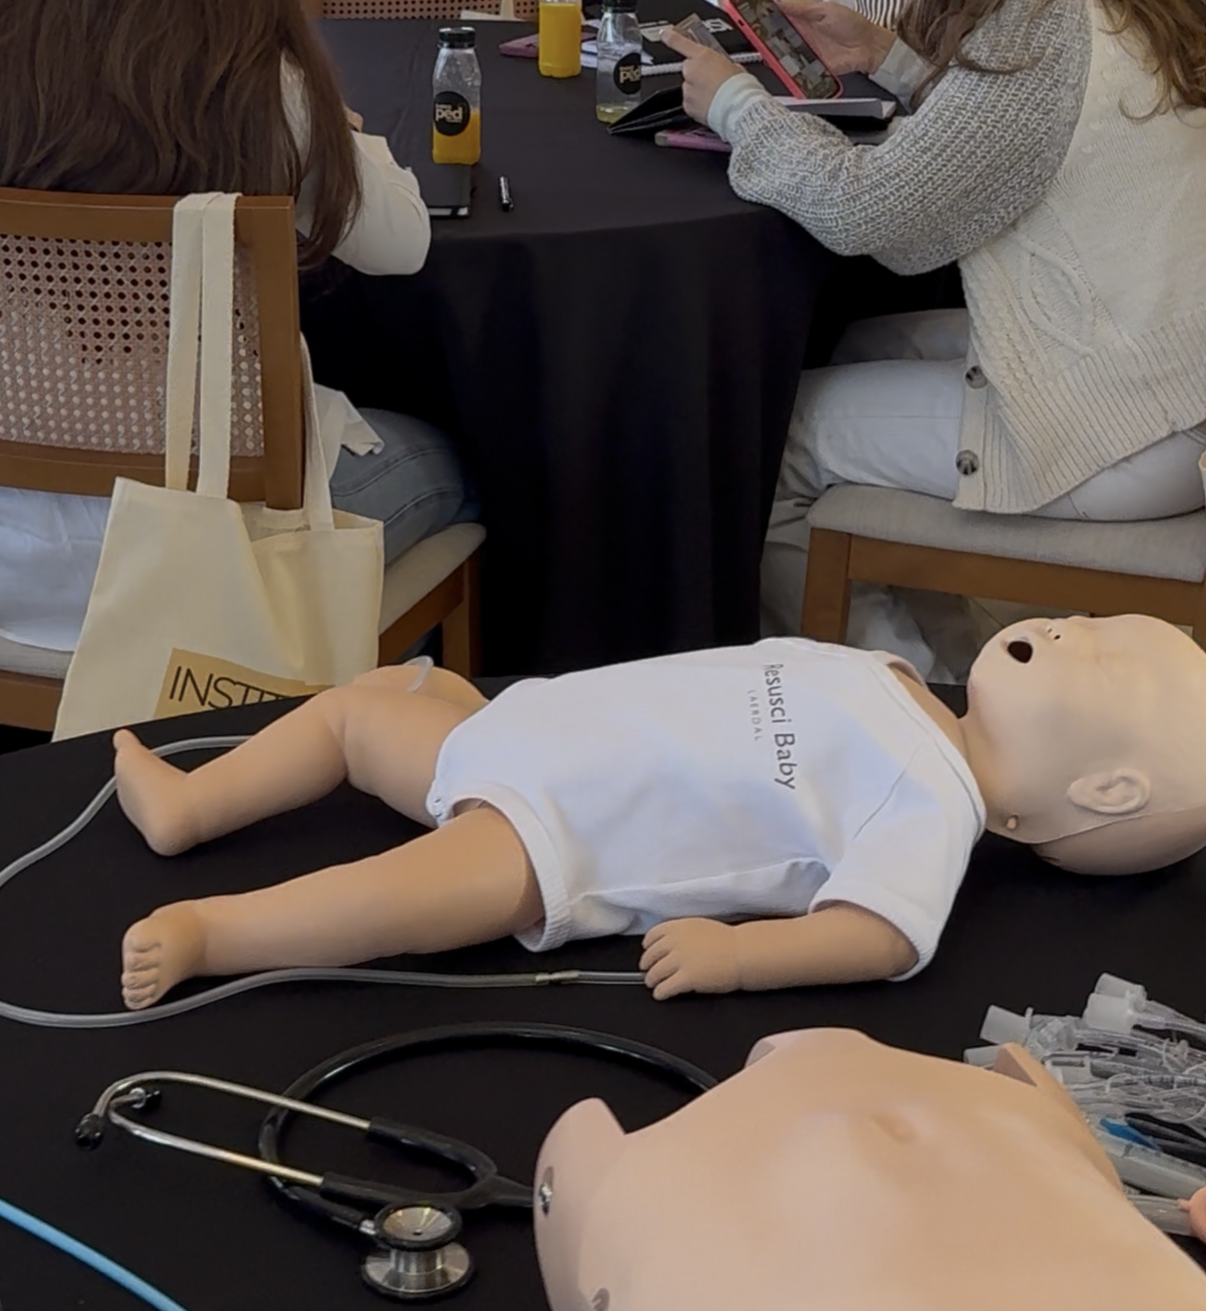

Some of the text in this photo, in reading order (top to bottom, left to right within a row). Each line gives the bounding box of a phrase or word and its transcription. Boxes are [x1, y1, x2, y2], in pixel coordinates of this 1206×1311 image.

[435, 106, 463, 123] ped
[763, 663, 798, 790] Resusci Baby
